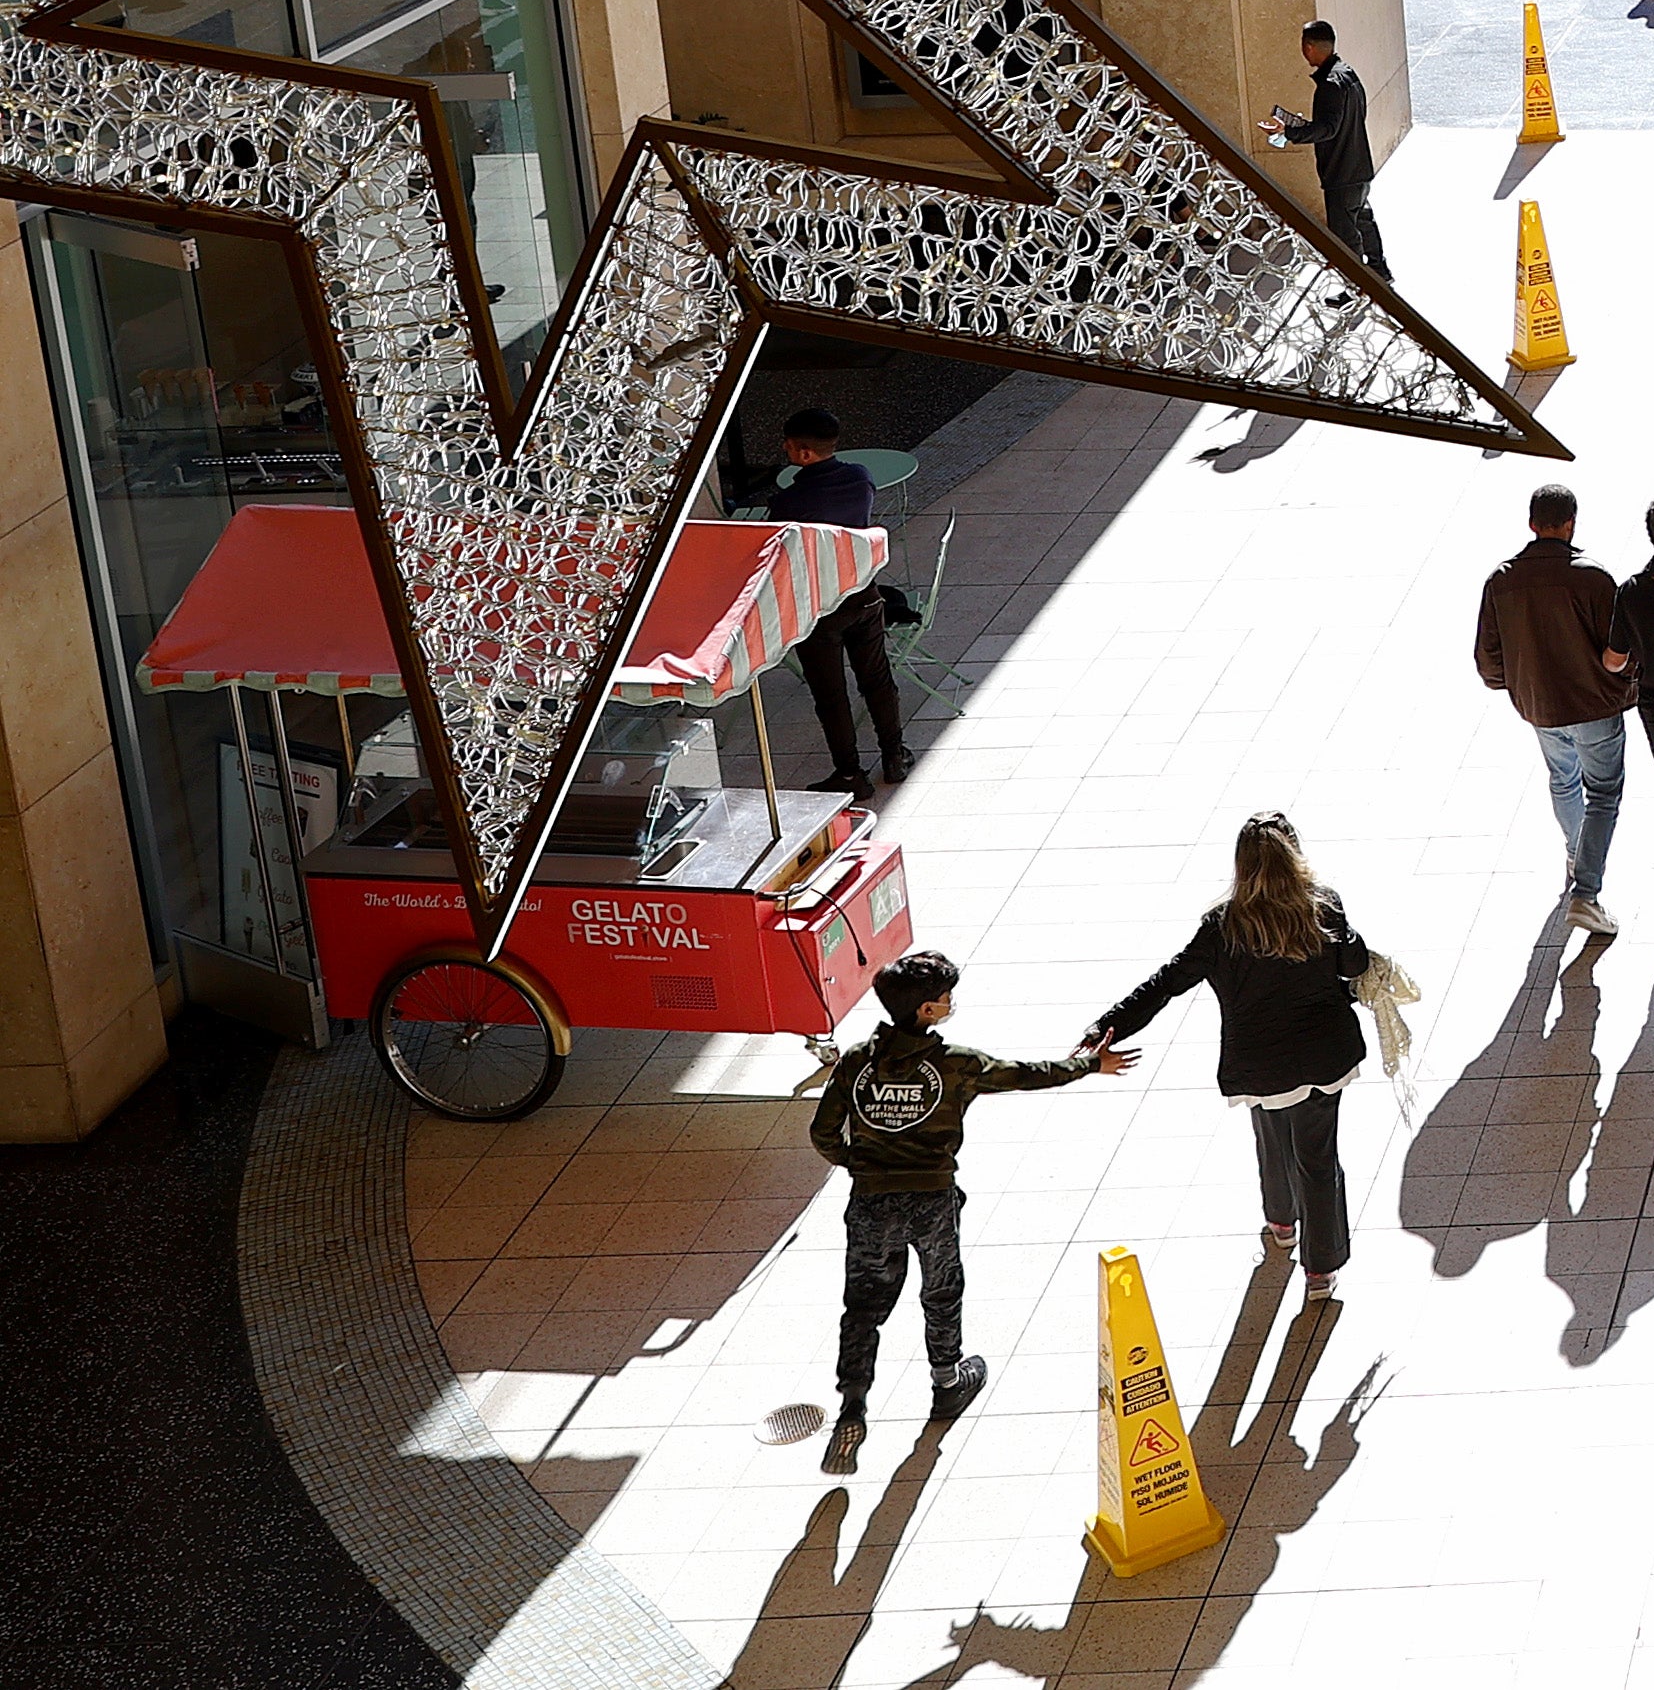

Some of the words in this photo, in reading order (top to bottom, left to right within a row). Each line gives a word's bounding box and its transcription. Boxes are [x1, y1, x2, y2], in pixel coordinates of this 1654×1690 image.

[364, 893, 390, 907] The
[391, 894, 450, 908] World's
[571, 899, 688, 924] GELATO
[870, 1083, 924, 1103] VANS
[864, 1104, 881, 1112] OFF
[883, 1104, 899, 1112] THE
[901, 1104, 926, 1112] WALL
[1125, 1369, 1158, 1387] CAUTION
[1126, 1382, 1161, 1401] CUIDADO
[1126, 1393, 1167, 1414] ATTENTION
[1134, 1471, 1153, 1484] WET
[1154, 1460, 1182, 1477] FLOOR
[1131, 1484, 1151, 1498] PISO
[1153, 1469, 1190, 1490] MOJADO
[1136, 1496, 1153, 1508] SOL
[1154, 1481, 1188, 1501] HUMIDE
